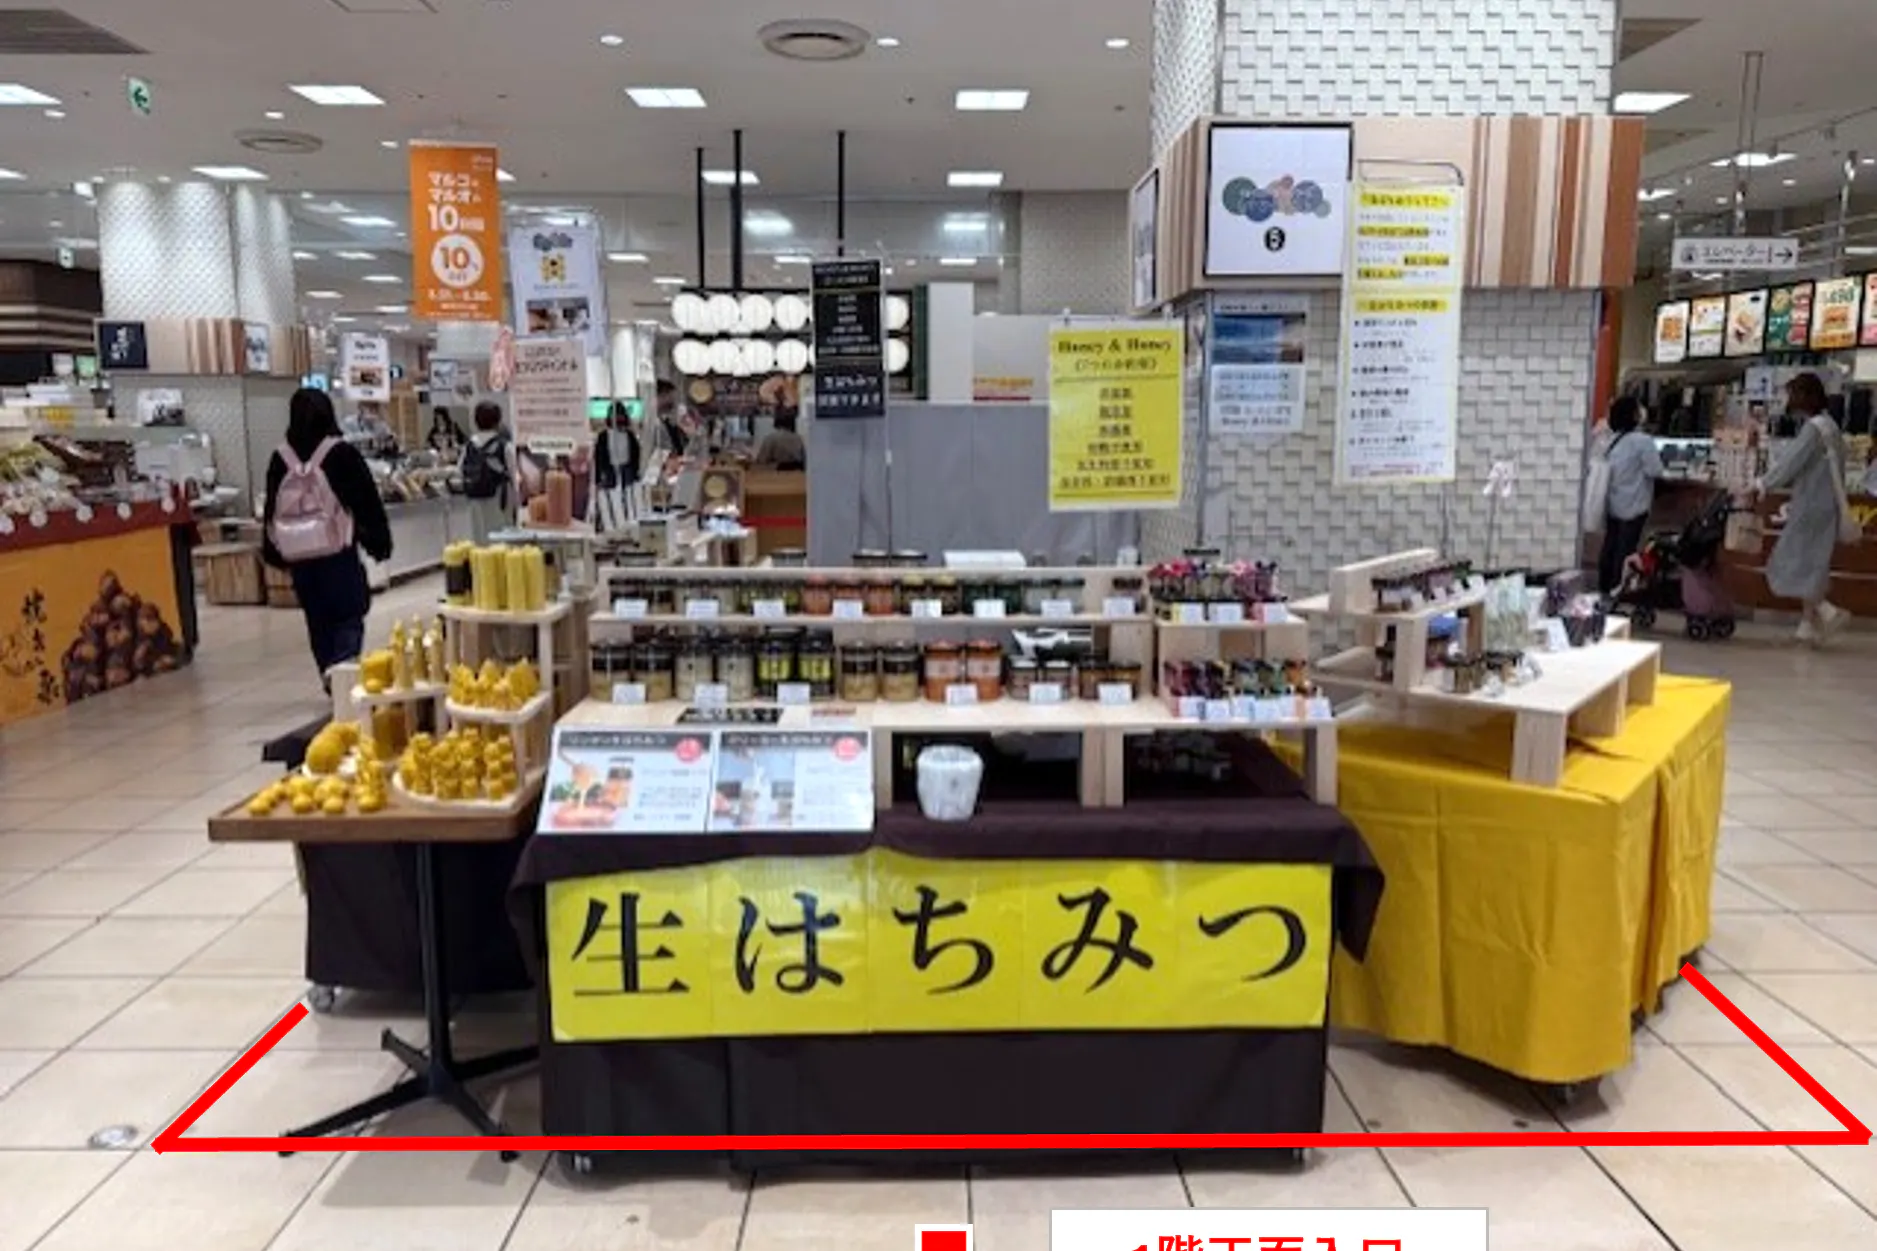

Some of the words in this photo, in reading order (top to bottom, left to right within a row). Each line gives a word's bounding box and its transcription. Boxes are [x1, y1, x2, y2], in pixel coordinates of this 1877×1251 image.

[1058, 341, 1104, 357] Honey
[1108, 340, 1122, 353] &
[1126, 338, 1173, 353] Honey
[571, 884, 1310, 998] 生はちみつ
